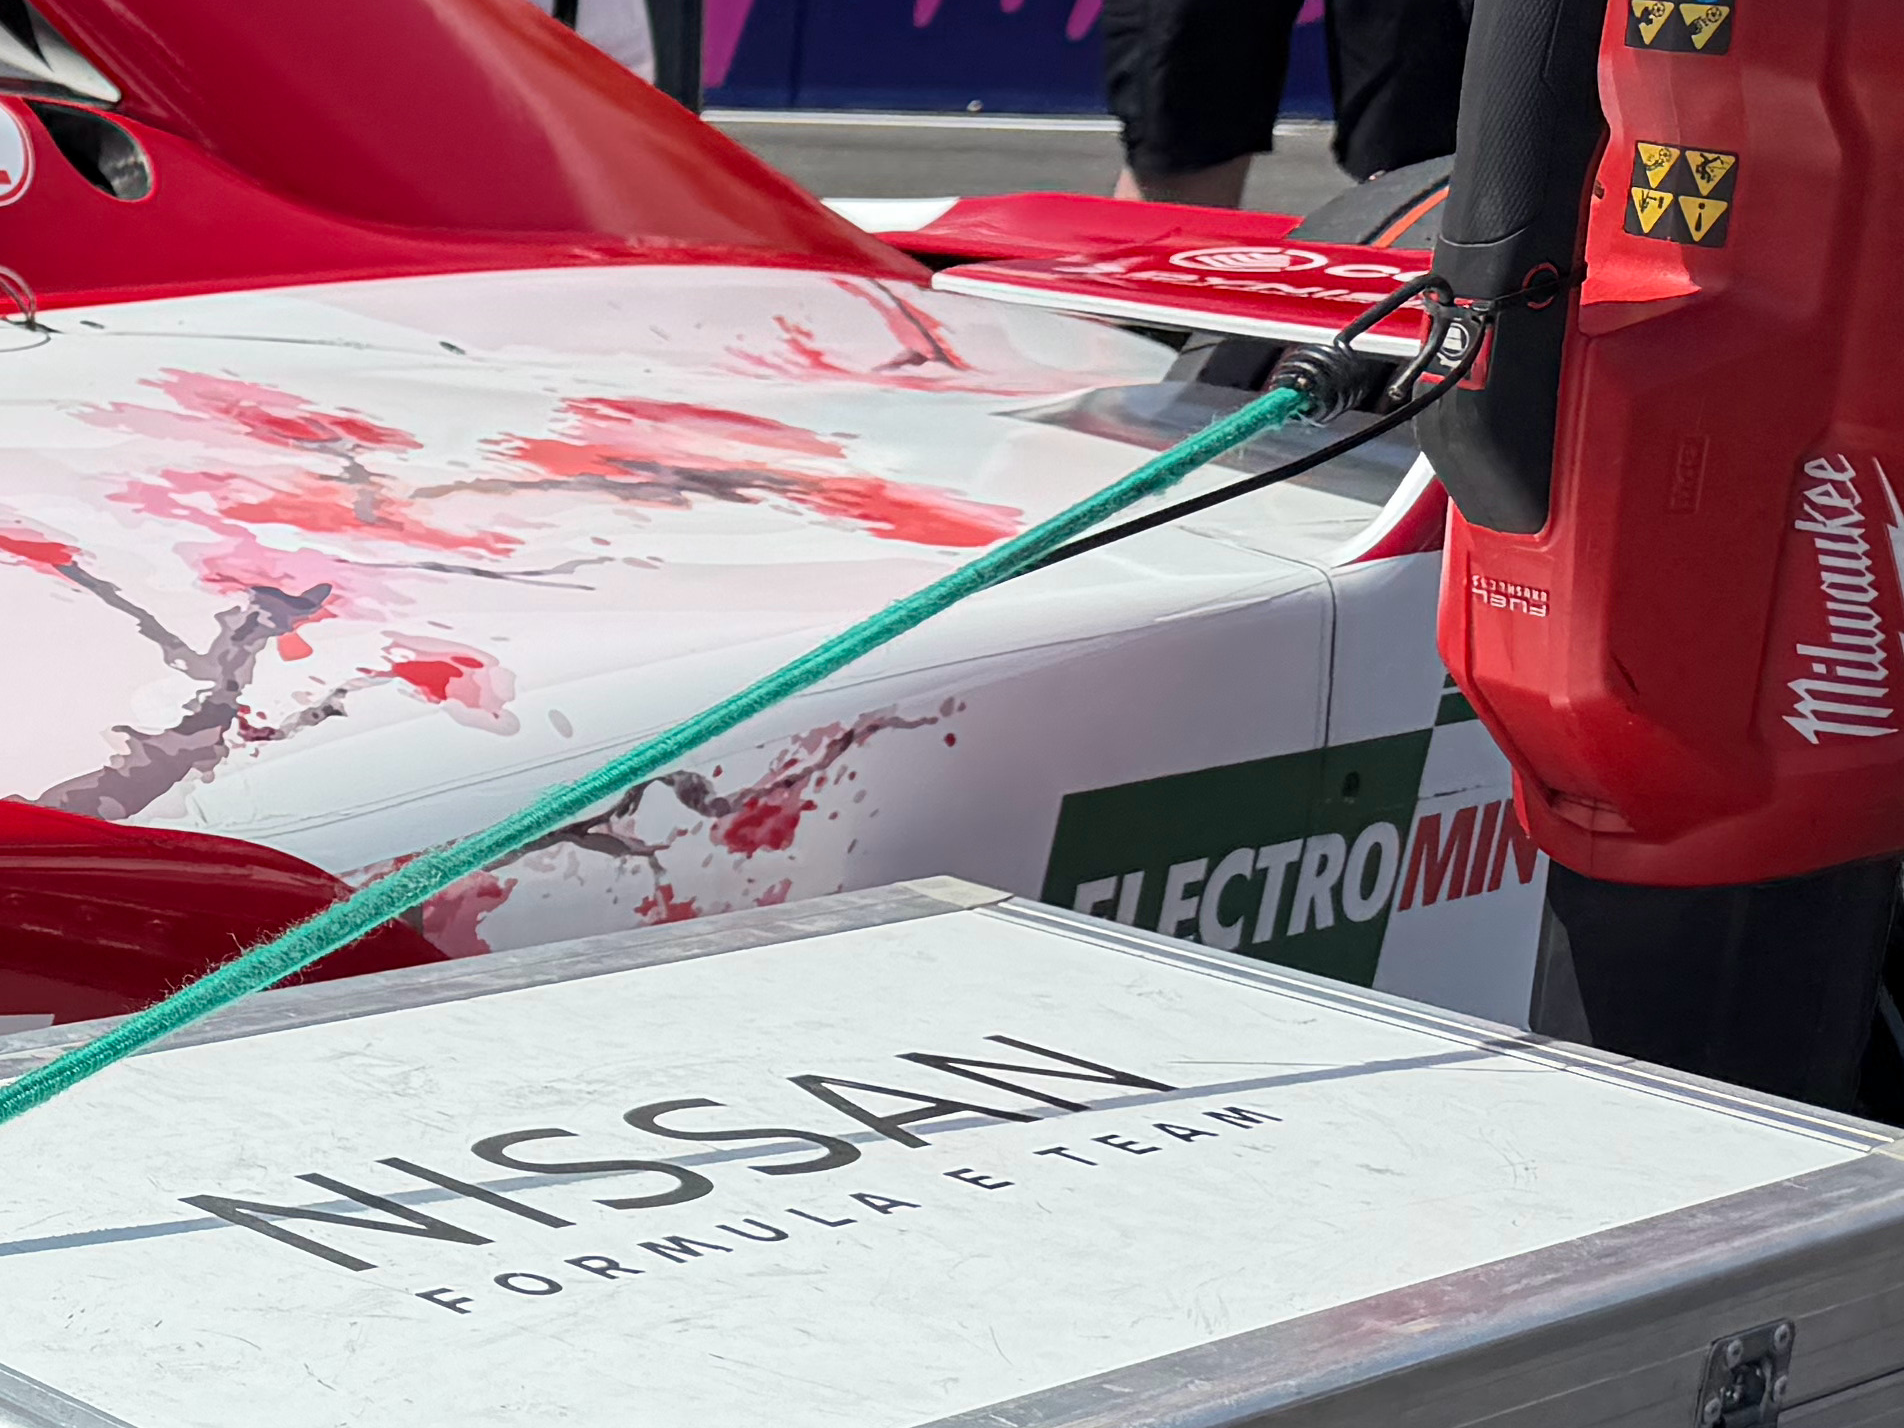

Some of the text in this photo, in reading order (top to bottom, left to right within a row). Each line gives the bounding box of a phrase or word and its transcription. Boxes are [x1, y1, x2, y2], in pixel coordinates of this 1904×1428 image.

[1782, 453, 1900, 745] Milwaukee
[179, 1034, 1179, 1272] NISSAN
[415, 1103, 1284, 1315] FORMULA E TEAM
